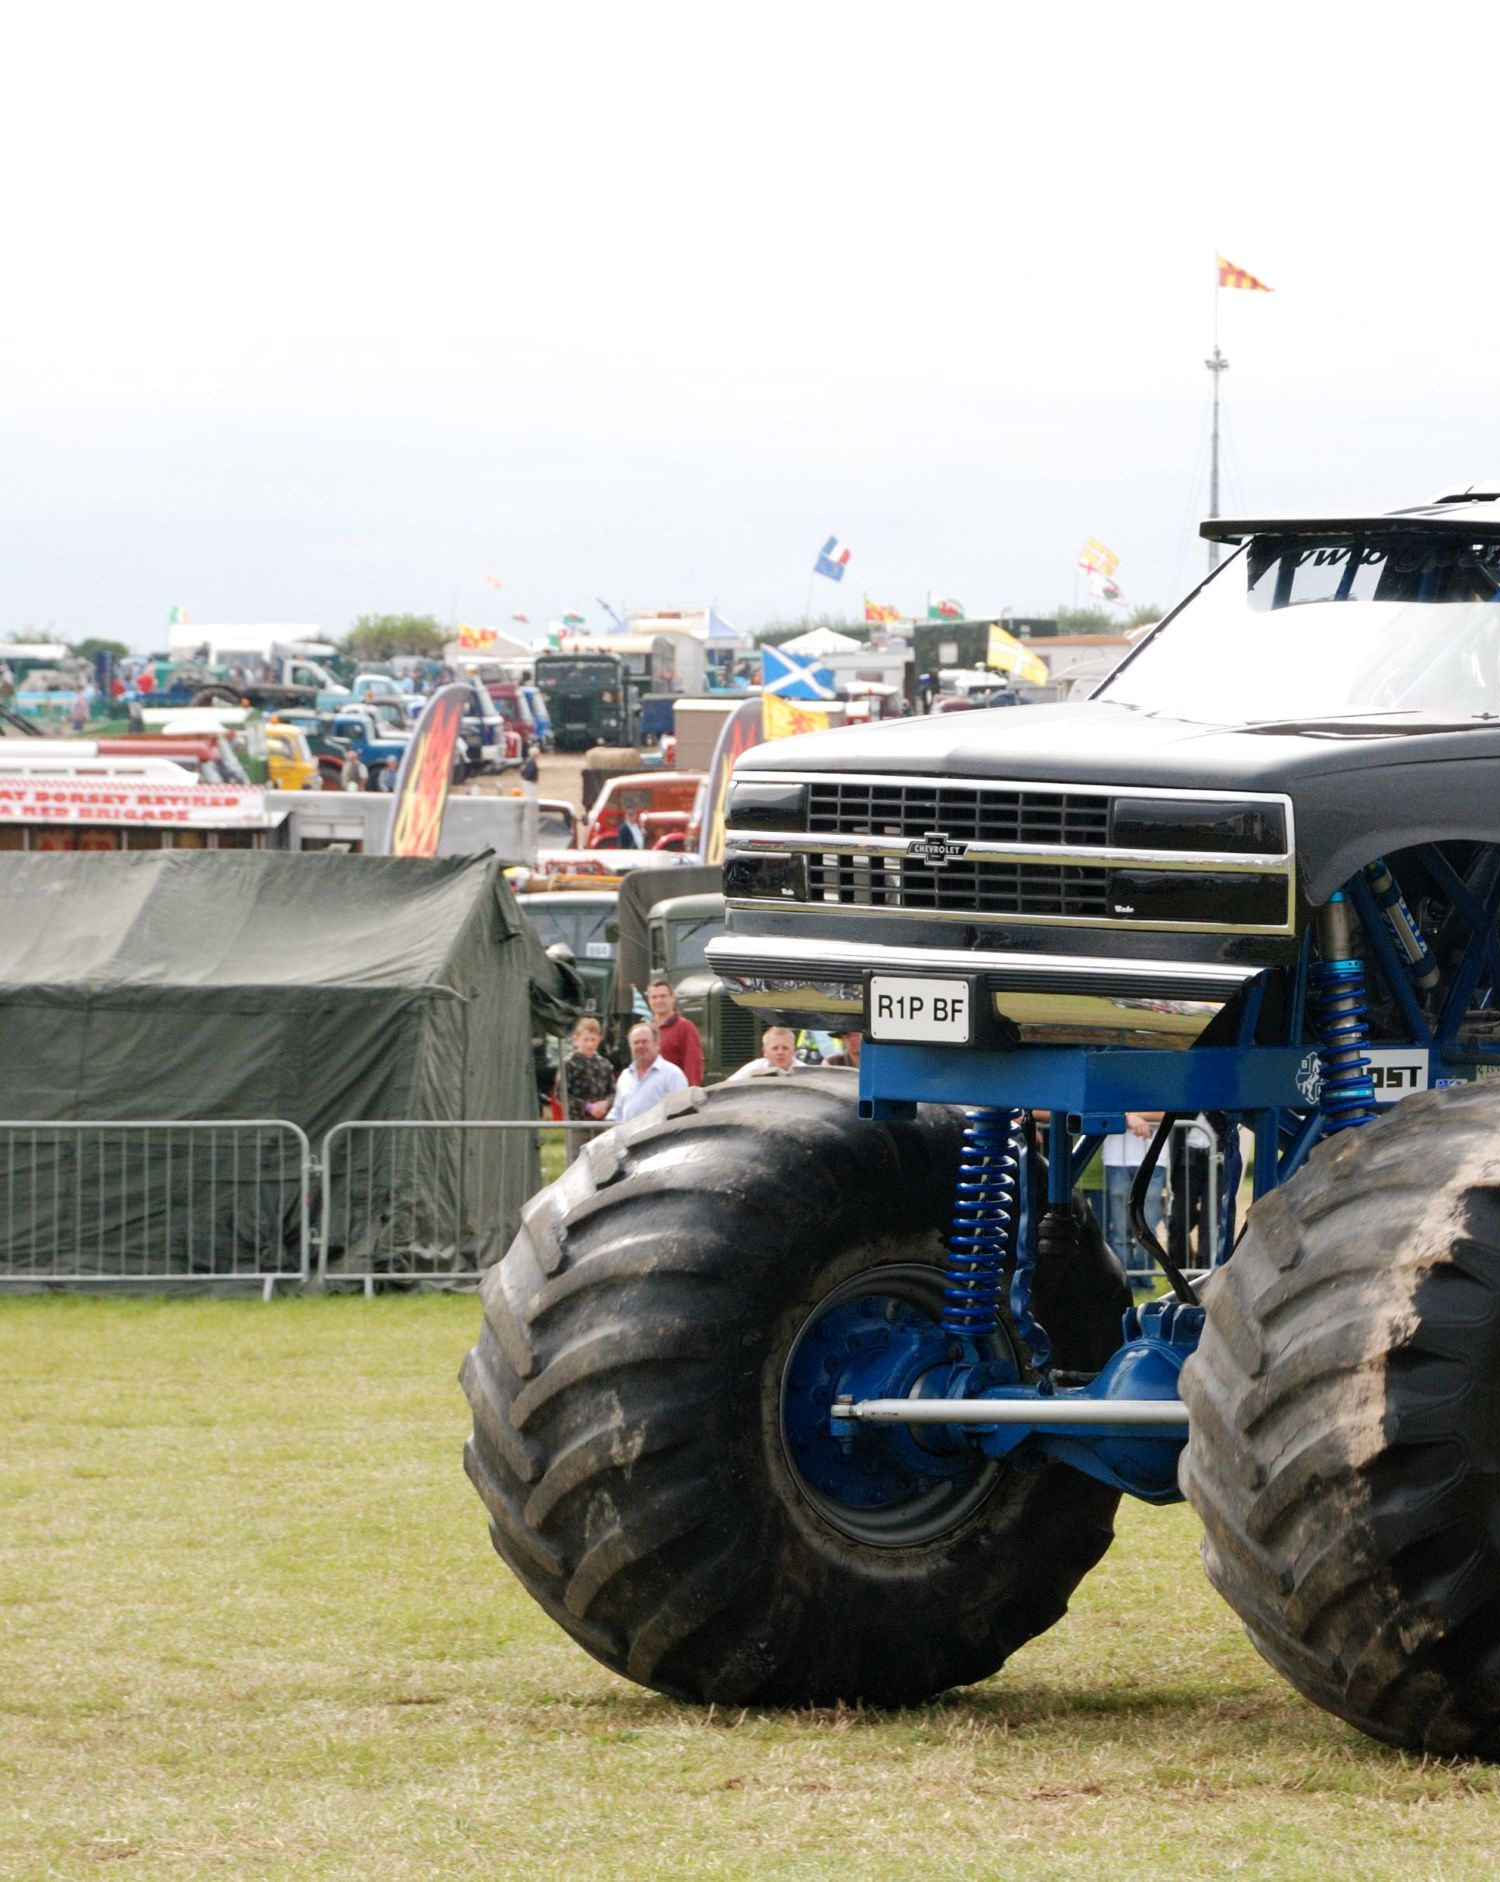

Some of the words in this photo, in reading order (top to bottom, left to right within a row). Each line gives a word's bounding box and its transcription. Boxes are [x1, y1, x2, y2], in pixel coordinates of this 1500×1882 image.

[35, 791, 129, 804] DORSET
[137, 795, 239, 807] RETIRED
[22, 806, 69, 817] RED
[78, 808, 190, 820] BRIGADE
[914, 844, 960, 855] CHEVROLET
[878, 994, 924, 1020] R1P
[933, 997, 964, 1022] BF
[1361, 1066, 1423, 1088] OST
